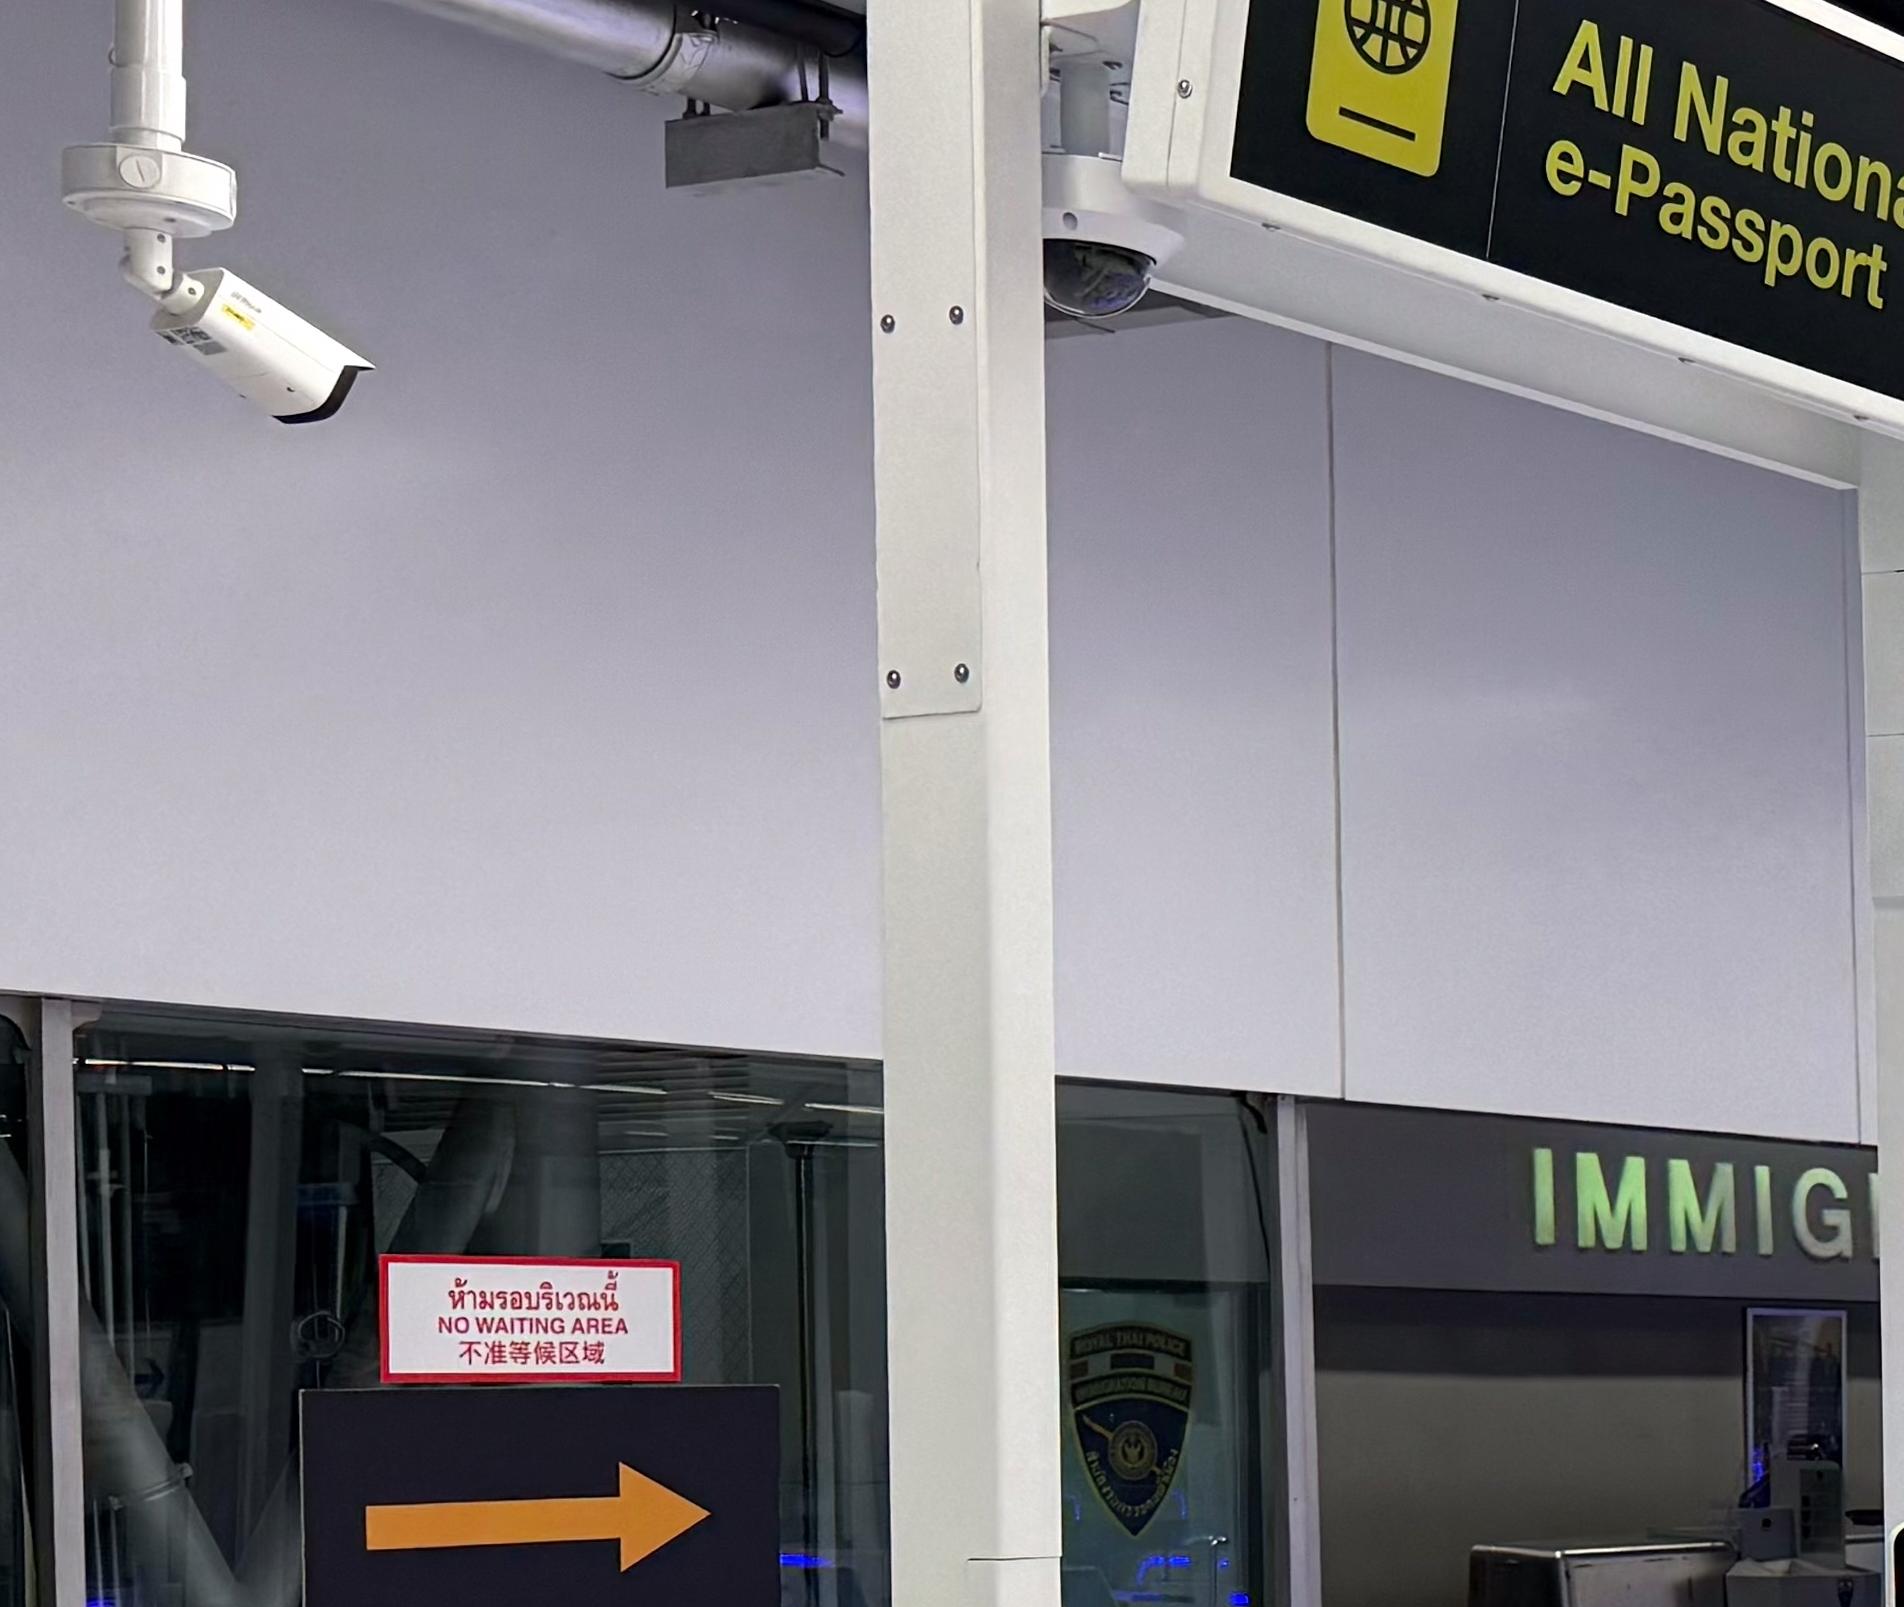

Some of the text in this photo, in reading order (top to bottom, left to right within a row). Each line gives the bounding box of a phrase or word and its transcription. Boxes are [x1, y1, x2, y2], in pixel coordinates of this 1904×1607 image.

[1552, 20, 1654, 125] All
[1545, 138, 1888, 311] e-Passport
[447, 1270, 620, 1312] ห้ามรอบริเวณนี้
[438, 1317, 628, 1336] NO WAITING AREA
[458, 1341, 606, 1366] 不准等候区域
